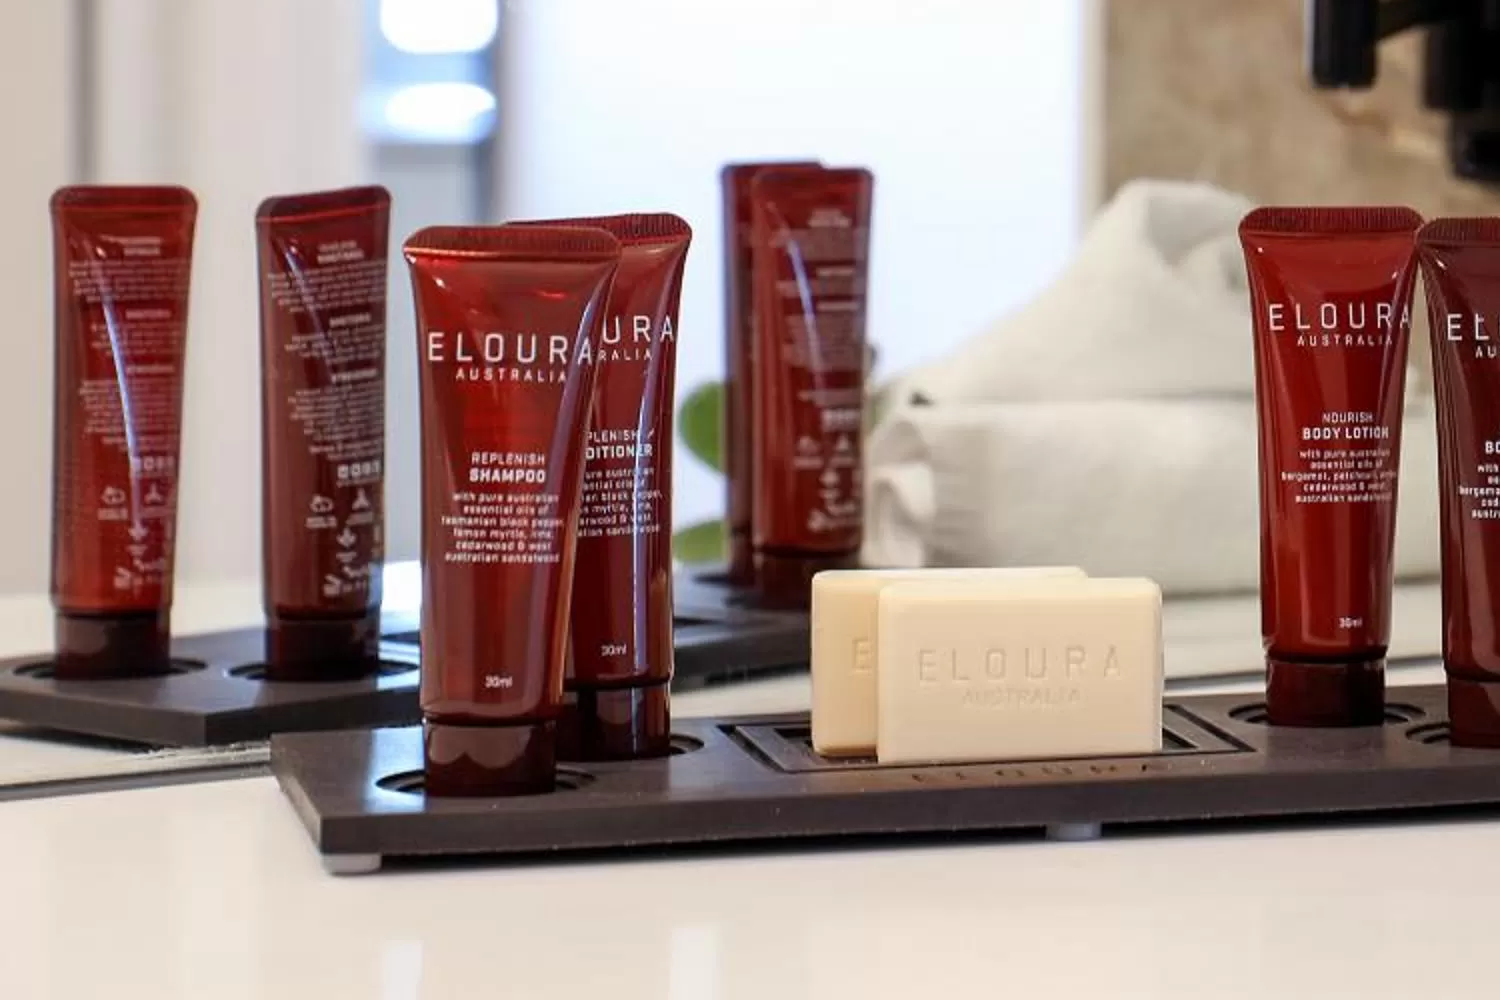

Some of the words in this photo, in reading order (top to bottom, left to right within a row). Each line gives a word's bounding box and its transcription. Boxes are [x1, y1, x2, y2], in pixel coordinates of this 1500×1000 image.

[1268, 303, 1412, 332] ELOURA
[602, 315, 675, 344] URA
[1297, 333, 1393, 347] AUSTRALIA
[428, 331, 593, 366] ELOURA
[600, 349, 653, 361] RALIA
[455, 368, 568, 384] AUSTRALIA
[1322, 411, 1373, 424] NOURISH
[588, 429, 641, 443] PLENISH
[1303, 427, 1341, 440] BODY
[1345, 426, 1389, 439] LOTION
[585, 444, 653, 459] DITIONER
[1299, 448, 1321, 458] with
[471, 452, 545, 466] REPLENISH
[469, 467, 546, 482] SHAMPOO
[1477, 464, 1499, 473] with
[478, 492, 503, 504] pure
[463, 504, 514, 515] essential
[455, 540, 515, 551] cedarwood
[445, 552, 499, 563] australian
[1339, 616, 1362, 628] 30ml
[600, 643, 627, 657] 30ml
[917, 643, 1122, 683] ELOURA
[484, 675, 513, 689] 30ml
